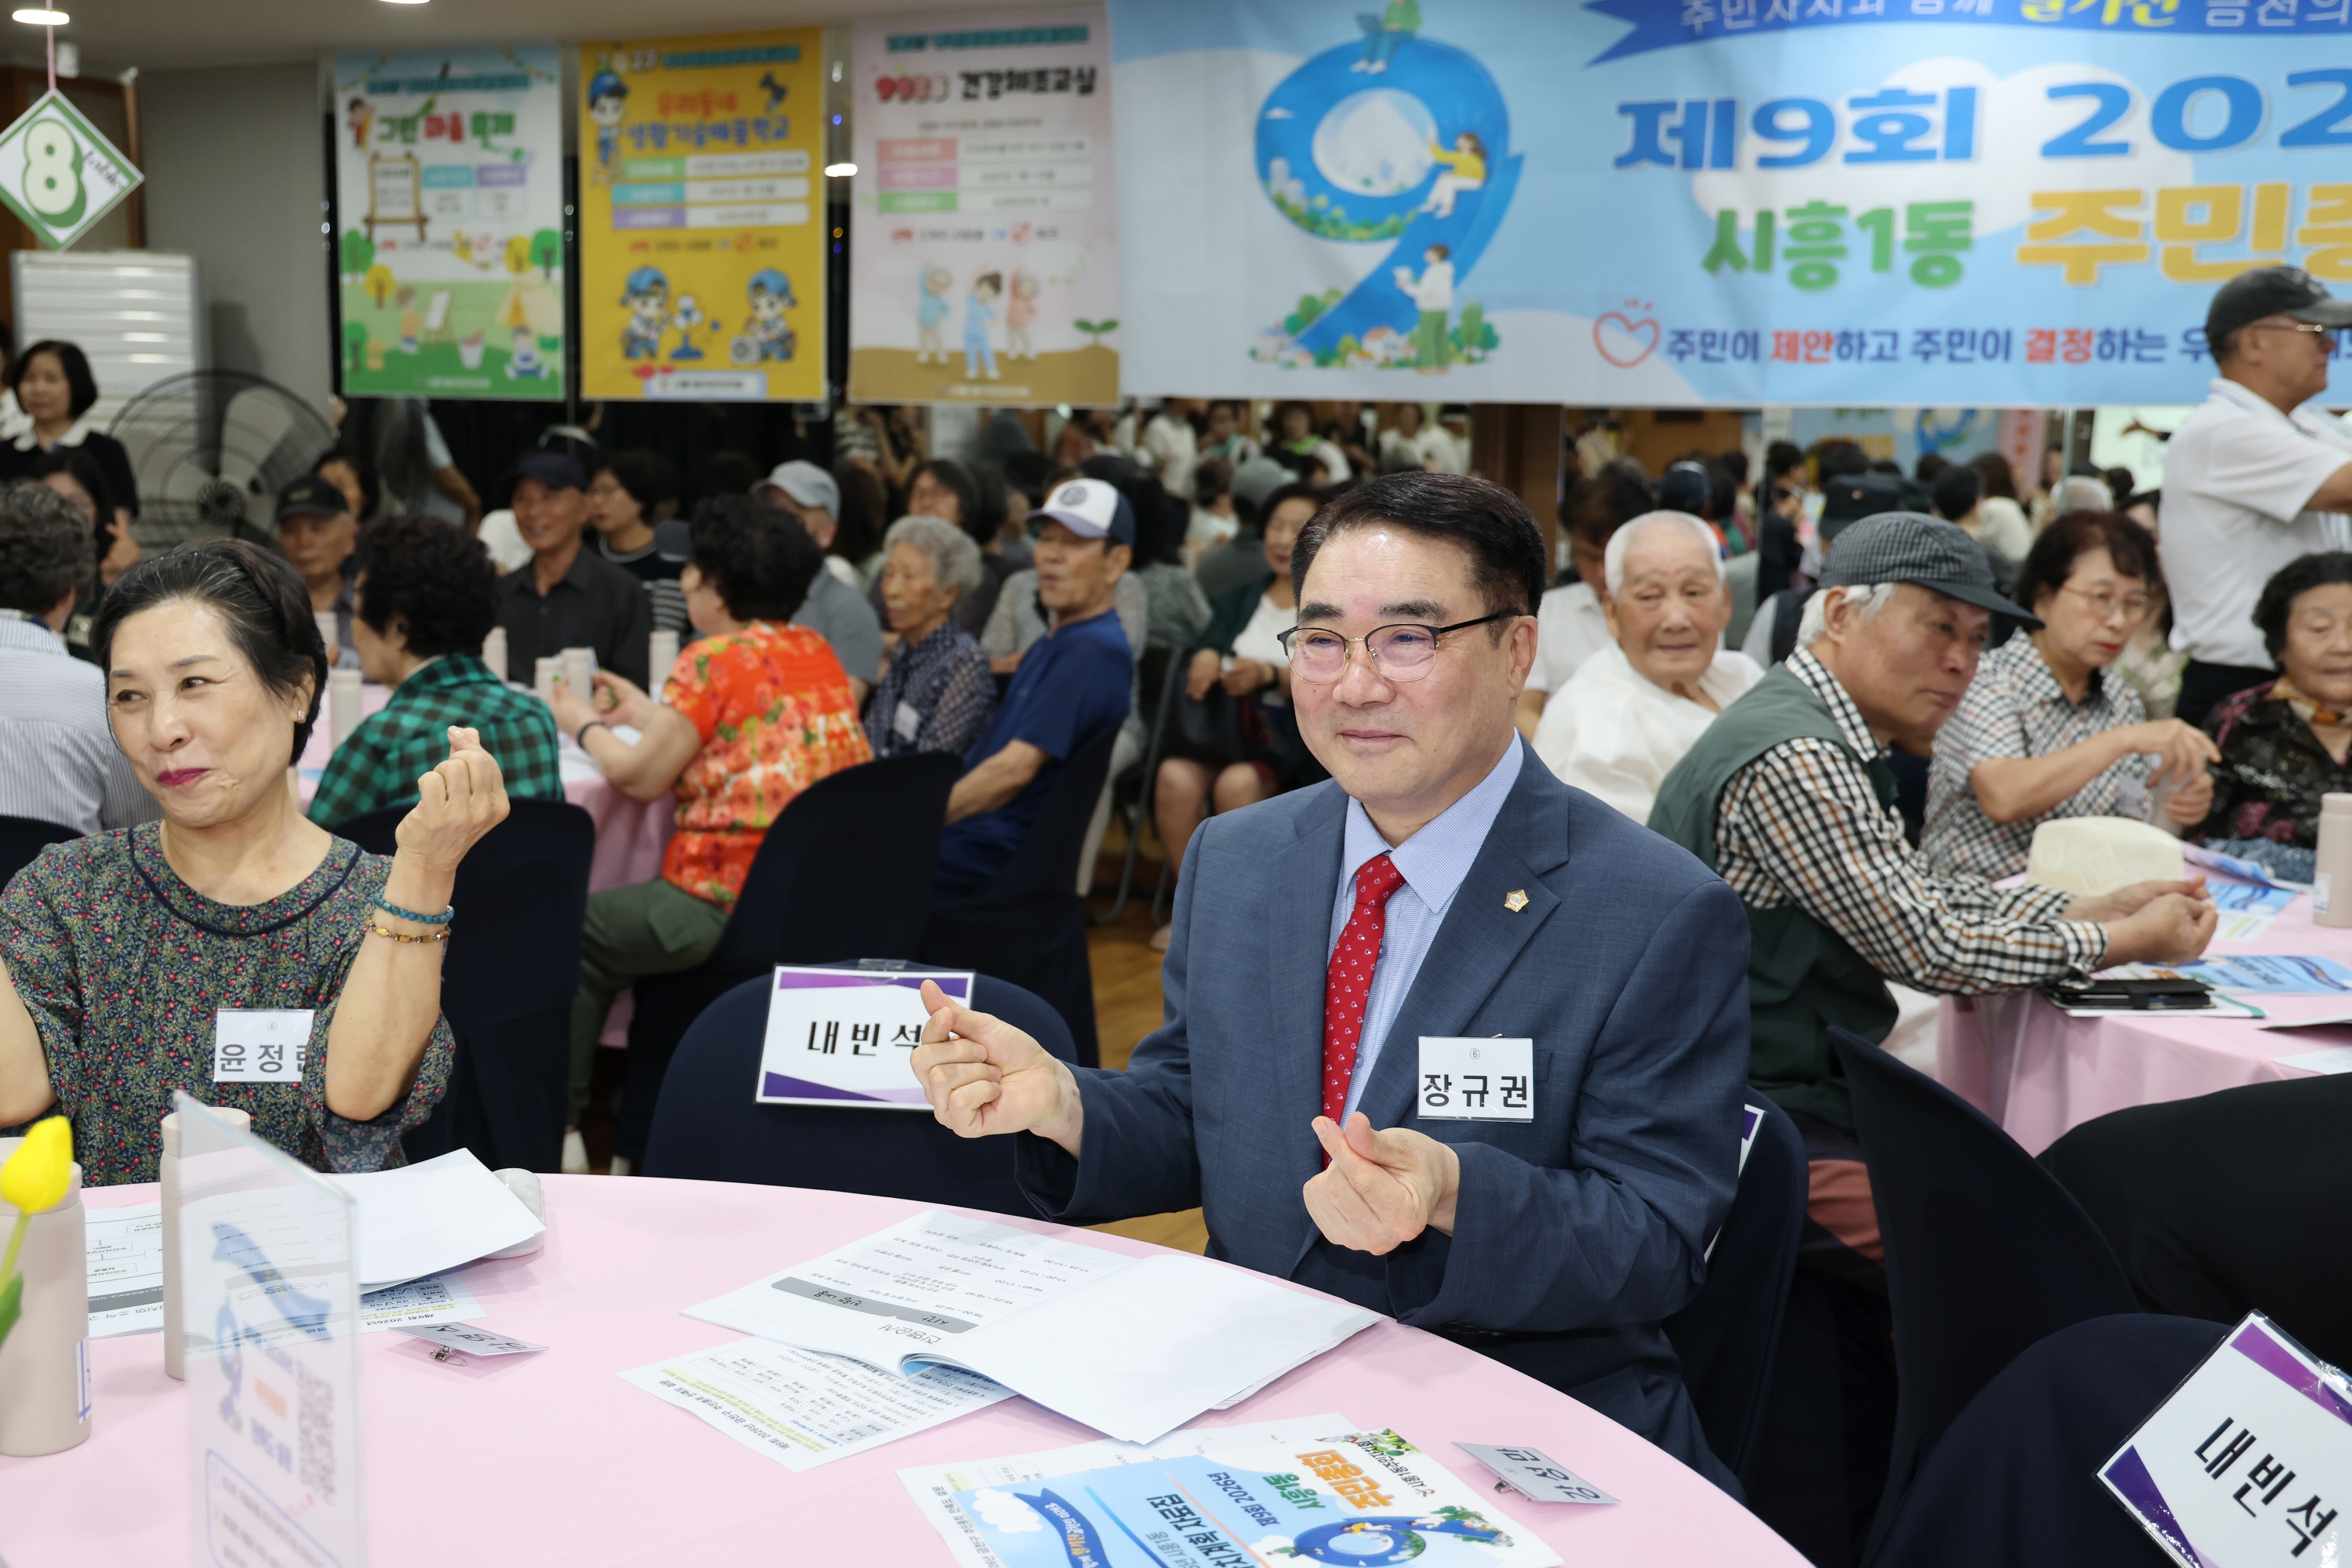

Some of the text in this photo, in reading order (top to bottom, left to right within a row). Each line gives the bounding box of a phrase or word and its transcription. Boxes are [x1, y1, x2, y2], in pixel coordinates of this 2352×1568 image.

[1613, 86, 1976, 171] 제9회
[23, 118, 85, 227] 8
[1700, 201, 1973, 291] 시흥1동
[1667, 329, 1759, 363] 주민이
[1769, 329, 1900, 364] 제안하고
[1911, 328, 2012, 363] 주민이
[2025, 327, 2166, 364] 결정하는
[1423, 1074, 1528, 1108] 장규권
[105, 1310, 129, 1319] 조직
[837, 1297, 862, 1306] 진행
[365, 1316, 402, 1326] 2026년
[877, 1323, 942, 1344] 진행순서
[922, 1316, 949, 1324] 시간
[673, 1387, 697, 1397] 만족도
[694, 1396, 722, 1410] 주민총회
[721, 1410, 746, 1423] 금천구
[742, 1423, 771, 1438] 2026년
[768, 1437, 790, 1449] 제9회
[1261, 1472, 1326, 1510] 시흥1동
[1294, 1449, 1396, 1510] 주민총회
[1496, 1447, 1600, 1501] 강성만
[2194, 1417, 2338, 1558] 내빈석
[1145, 1494, 1208, 1532] 자료집
[1206, 1472, 1281, 1527] 제9회 2026년
